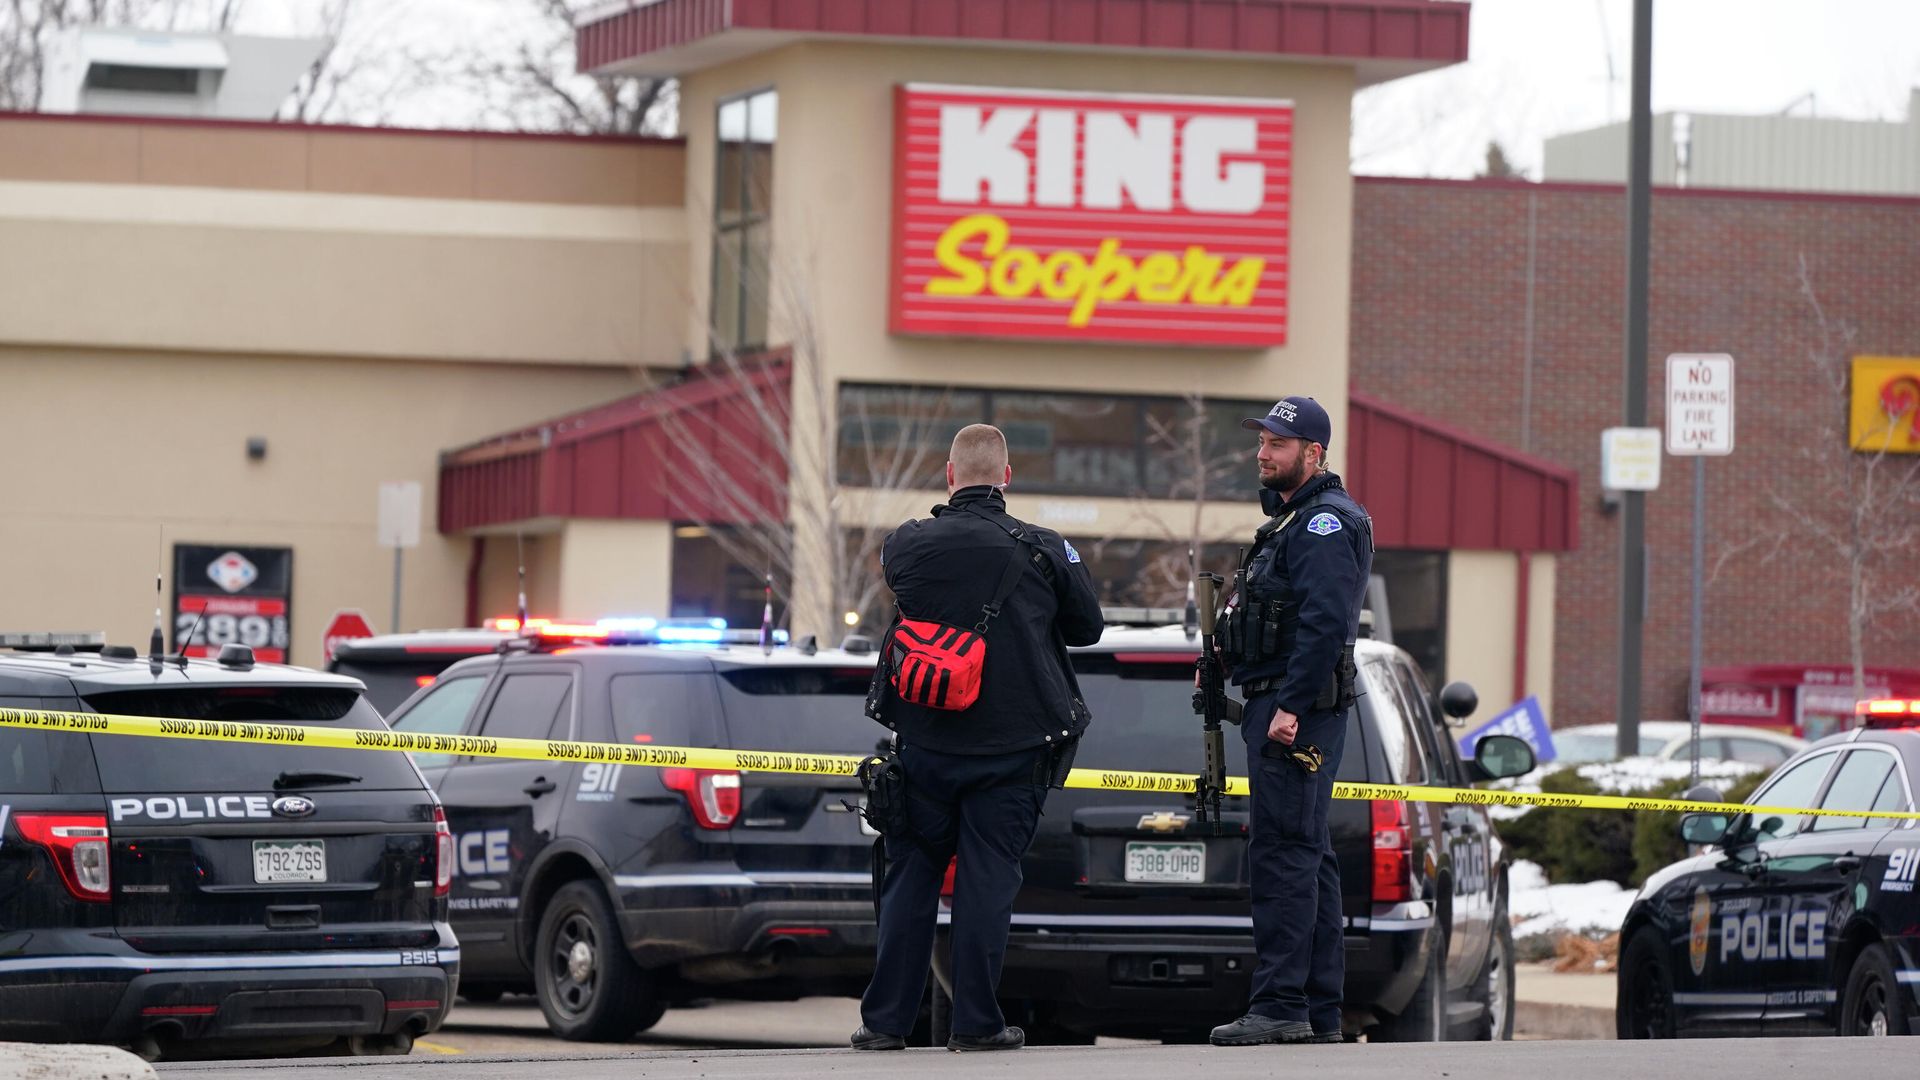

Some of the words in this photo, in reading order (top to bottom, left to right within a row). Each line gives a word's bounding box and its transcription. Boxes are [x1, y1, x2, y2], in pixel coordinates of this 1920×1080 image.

[938, 104, 1266, 214] KING
[926, 214, 1266, 327] Soopers
[1688, 367, 1712, 384] NO
[1674, 390, 1727, 405] PARKING
[1268, 405, 1297, 422] LICE
[1685, 409, 1714, 424] FIRE
[1682, 429, 1716, 443] LANE
[0, 710, 21, 723] NOT
[24, 711, 39, 724] DO
[42, 712, 66, 726] LINE
[70, 714, 108, 729] POLICE
[160, 719, 195, 735] CROSS
[198, 722, 219, 736] NOT
[223, 723, 237, 737] DO
[240, 725, 264, 739] LINE
[267, 726, 305, 741] POLICE
[356, 731, 390, 746] CROSS
[393, 734, 414, 748] NOT
[417, 735, 431, 749] DO
[434, 736, 457, 751] LINE
[460, 738, 497, 753] POLICE
[547, 743, 582, 757] CROSS
[584, 745, 605, 760] NOT
[608, 746, 622, 760] DO
[625, 748, 648, 762] LINE
[651, 750, 686, 765] POLICE
[736, 754, 769, 768] CROSS
[773, 756, 792, 770] NOT
[795, 757, 809, 771] DO
[812, 758, 834, 773] LINE
[579, 762, 622, 791] 911
[1101, 774, 1134, 788] CROSS
[1135, 776, 1156, 790] NOT
[1158, 777, 1172, 790] DO
[111, 796, 272, 821] POLICE
[451, 829, 509, 876] ICE
[1884, 848, 1920, 880] 911
[1721, 911, 1827, 962] POLICE
[402, 952, 437, 965] 2515
